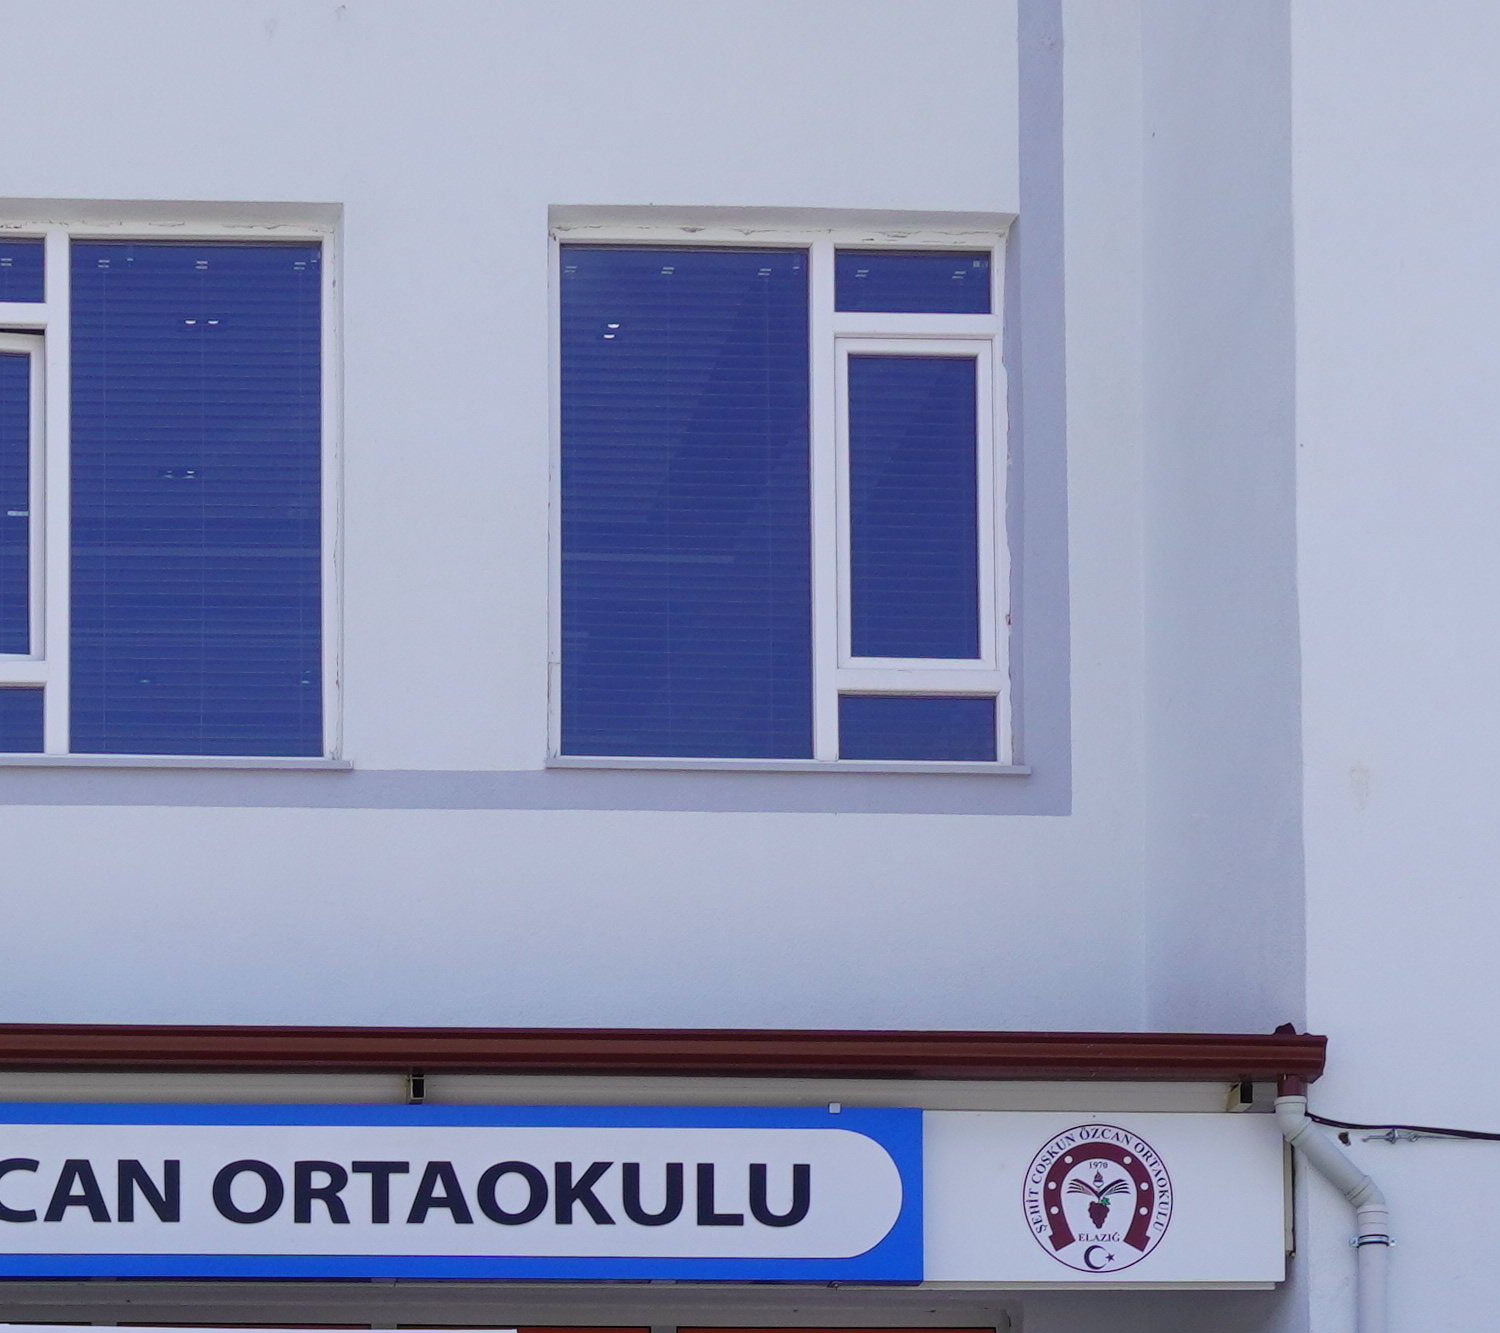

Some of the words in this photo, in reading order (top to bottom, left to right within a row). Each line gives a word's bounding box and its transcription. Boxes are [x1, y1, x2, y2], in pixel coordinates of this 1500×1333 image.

[1031, 1133, 1077, 1185] COŞKUN
[1079, 1127, 1133, 1146] ÖZCAN
[212, 1159, 812, 1228] ORTAOKULU
[1026, 1188, 1048, 1234] ŞEHİT
[1133, 1142, 1170, 1233] ORTAOKULU
[1077, 1231, 1121, 1243] ELAZIĞ
